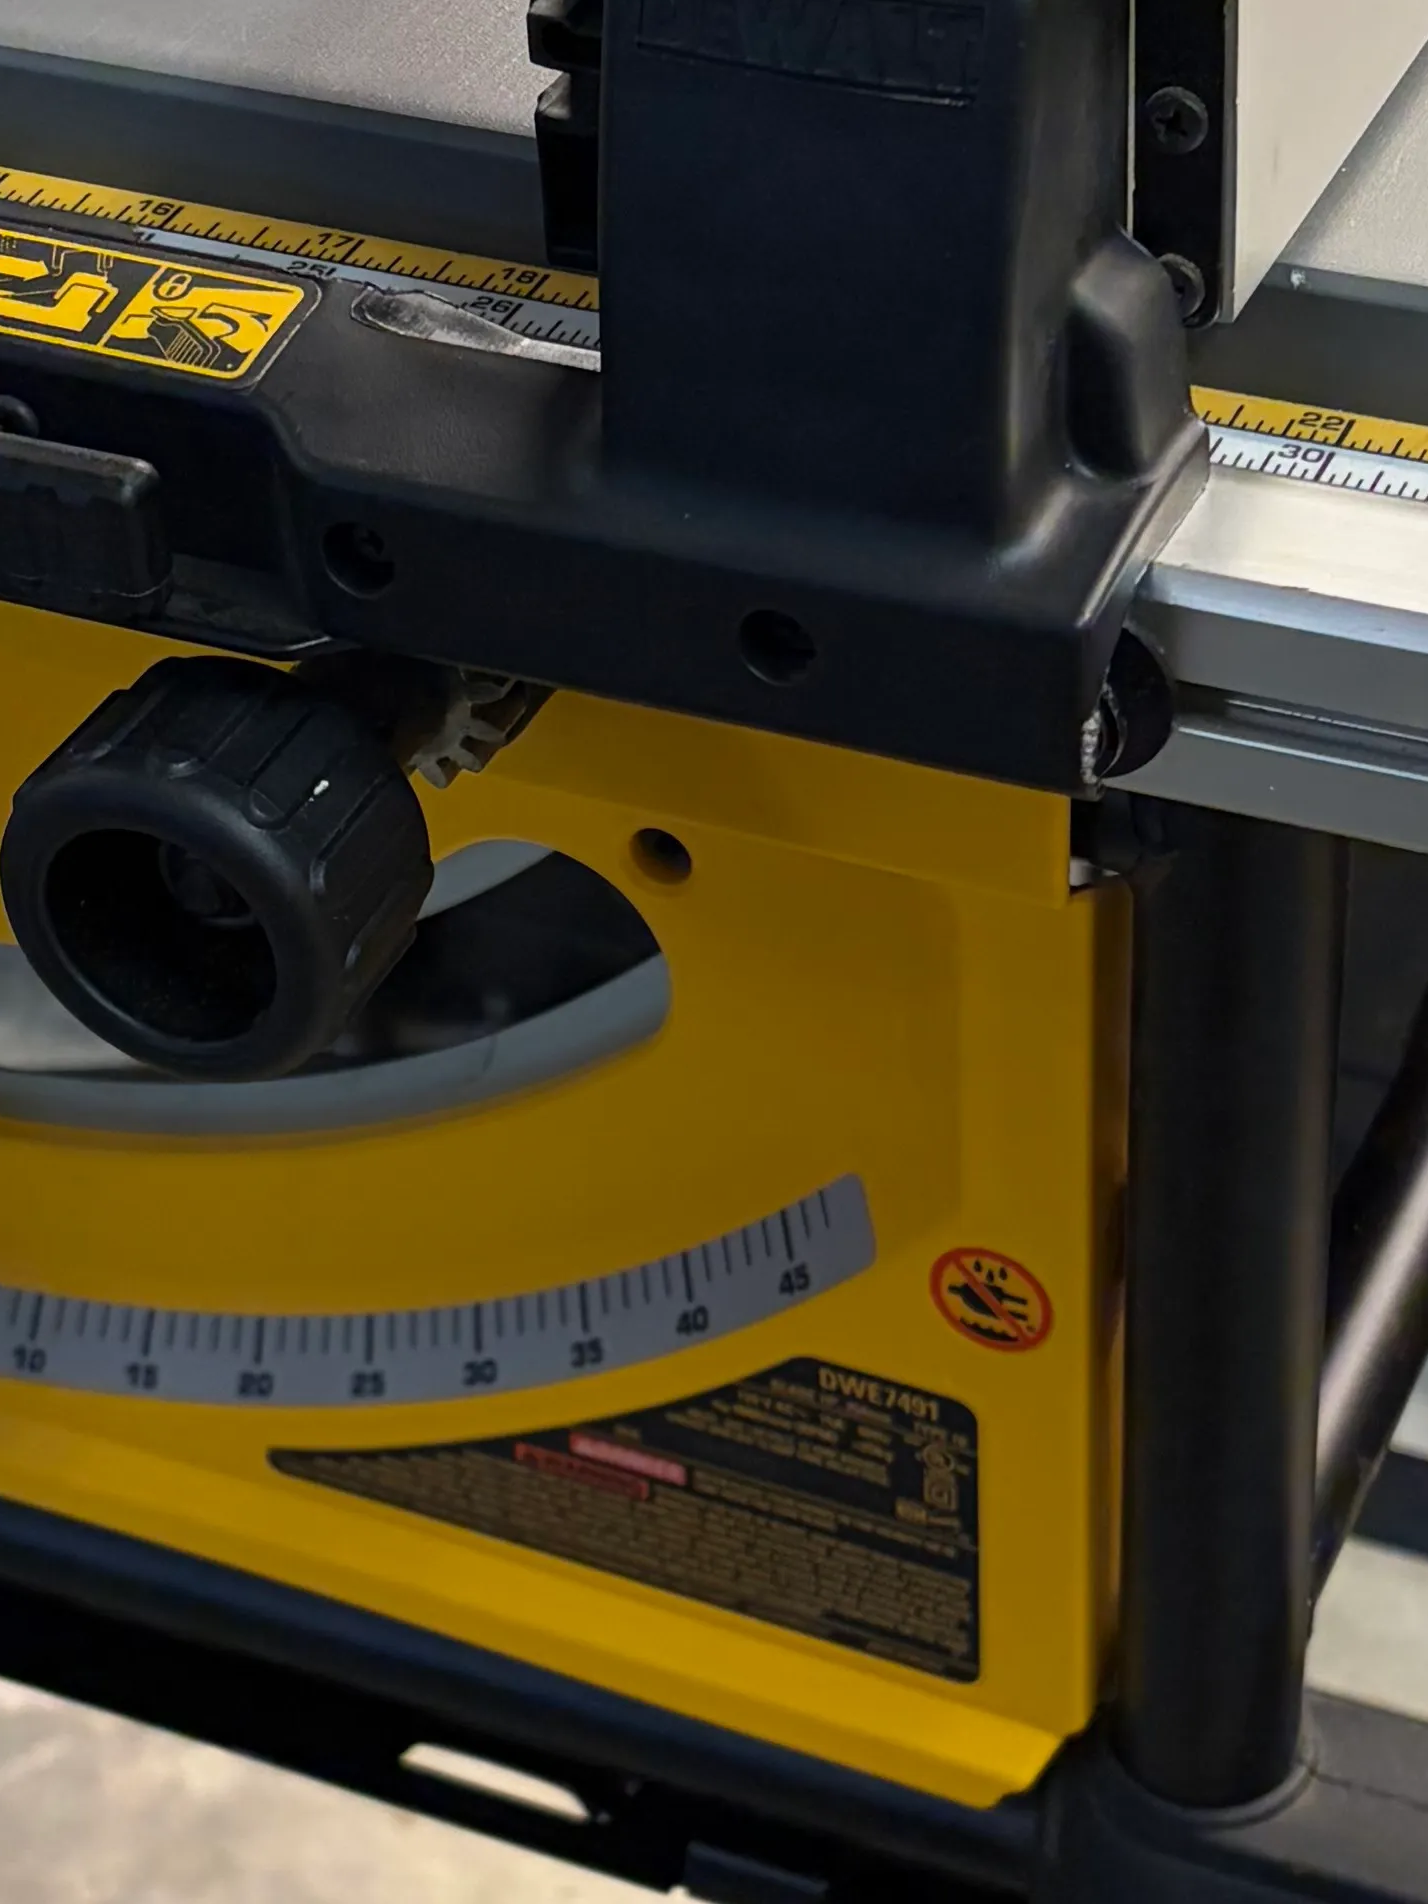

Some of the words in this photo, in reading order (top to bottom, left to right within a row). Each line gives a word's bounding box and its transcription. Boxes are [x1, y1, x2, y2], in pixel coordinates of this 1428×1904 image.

[138, 199, 174, 217] 16
[316, 232, 354, 249] 17
[500, 266, 538, 286] 18
[470, 296, 513, 313] 26
[1298, 411, 1345, 432] 22
[1276, 444, 1322, 463] 30
[14, 1346, 46, 1373] 10
[127, 1363, 157, 1390] 15
[238, 1371, 274, 1397] 20
[352, 1371, 385, 1397] 25
[463, 1359, 498, 1385] 30
[572, 1339, 603, 1366] 35
[675, 1306, 709, 1335] 40
[779, 1265, 810, 1294] 45
[818, 1366, 941, 1422] DWE7491
